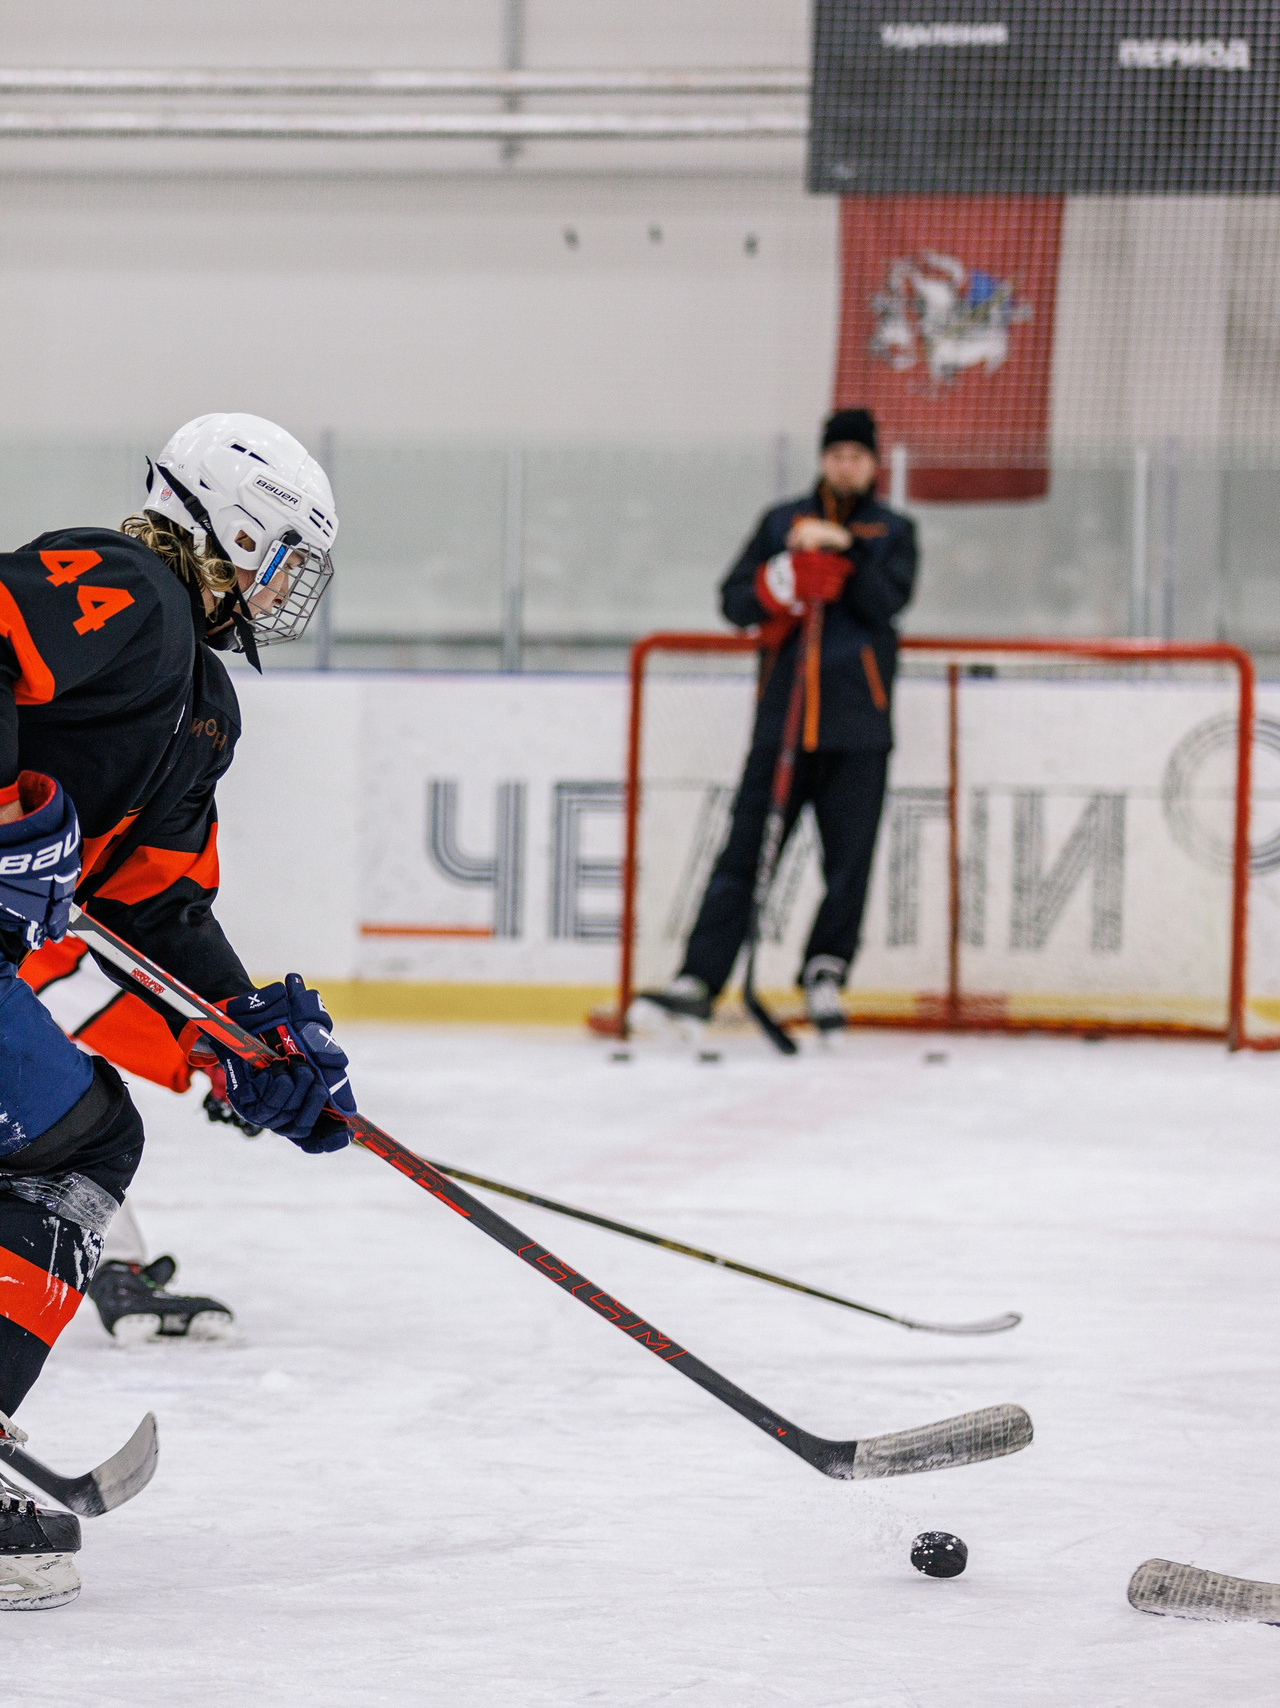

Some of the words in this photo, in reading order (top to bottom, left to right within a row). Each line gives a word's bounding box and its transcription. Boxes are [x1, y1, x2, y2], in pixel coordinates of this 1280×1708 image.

[1119, 38, 1250, 71] ПЕРИОД
[255, 479, 299, 505] BAUER
[38, 549, 136, 636] 44
